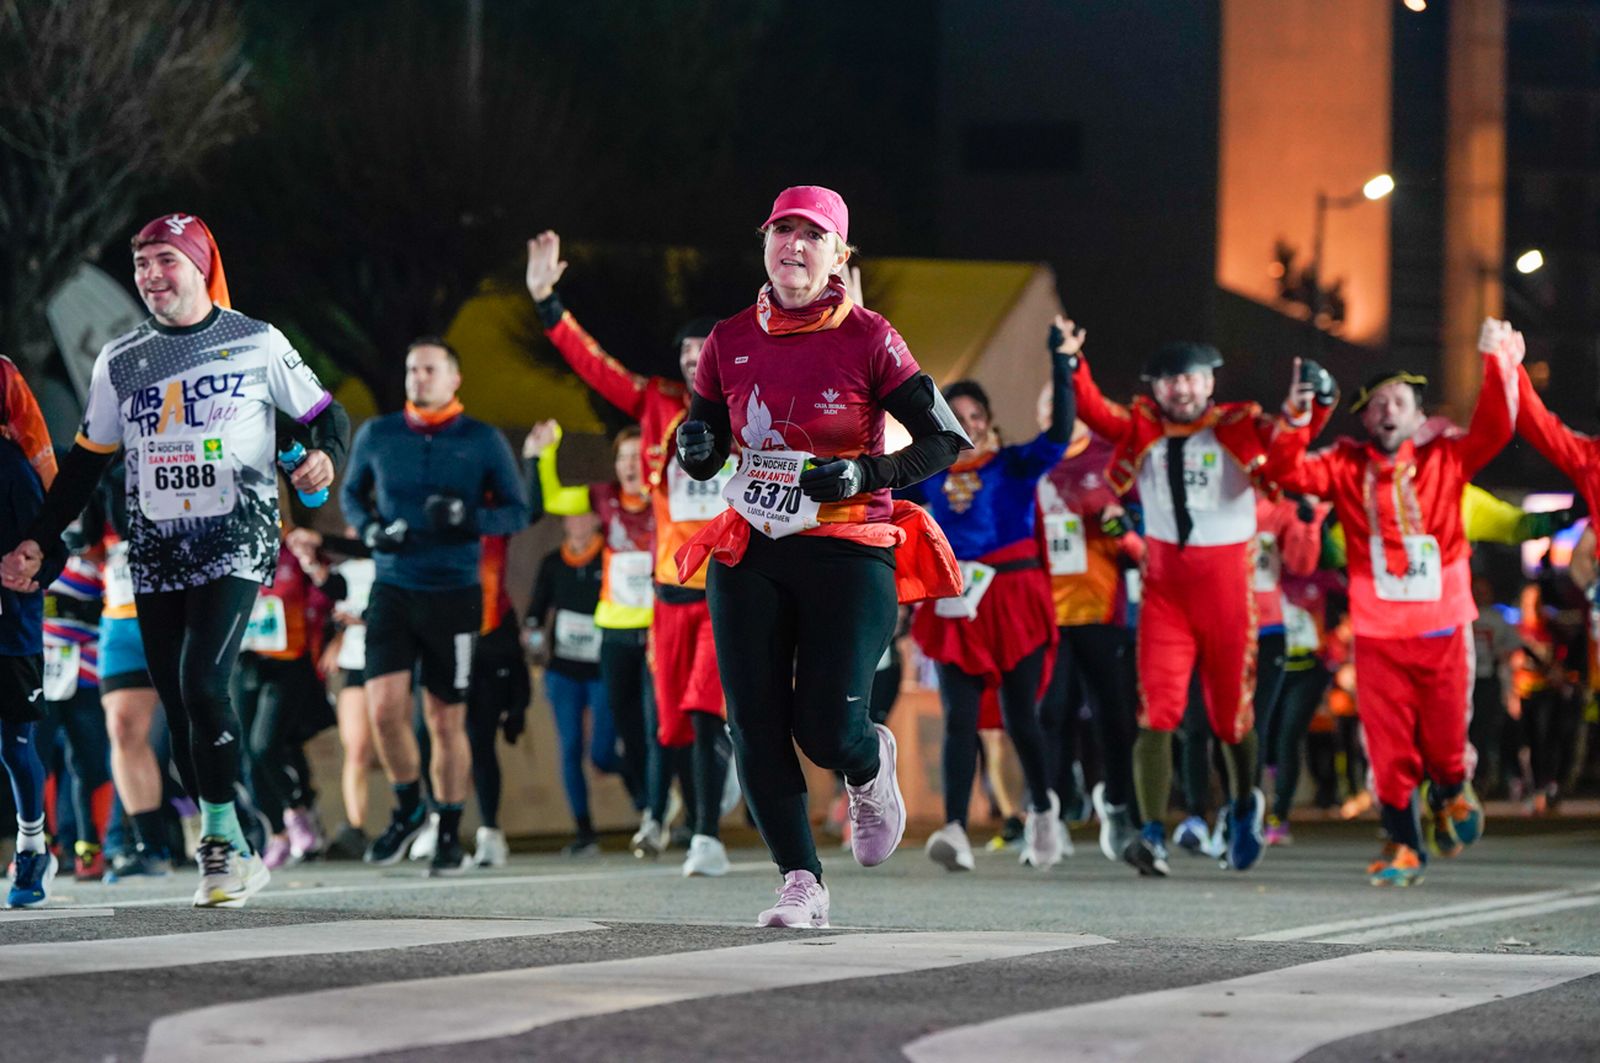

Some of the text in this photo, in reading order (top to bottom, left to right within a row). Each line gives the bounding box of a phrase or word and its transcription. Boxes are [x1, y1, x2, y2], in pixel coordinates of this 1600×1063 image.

[124, 374, 245, 424] JABALCUZ
[137, 396, 204, 437] TRAIL
[157, 444, 182, 453] NOCHE
[184, 443, 194, 453] DE
[148, 455, 164, 465] SAN
[762, 459, 788, 471] NOCHE
[787, 462, 798, 472] DE
[155, 464, 216, 490] 6388
[748, 469, 768, 480] SAN
[743, 480, 802, 515] 5370
[747, 506, 791, 523] LUISA CARMEN
